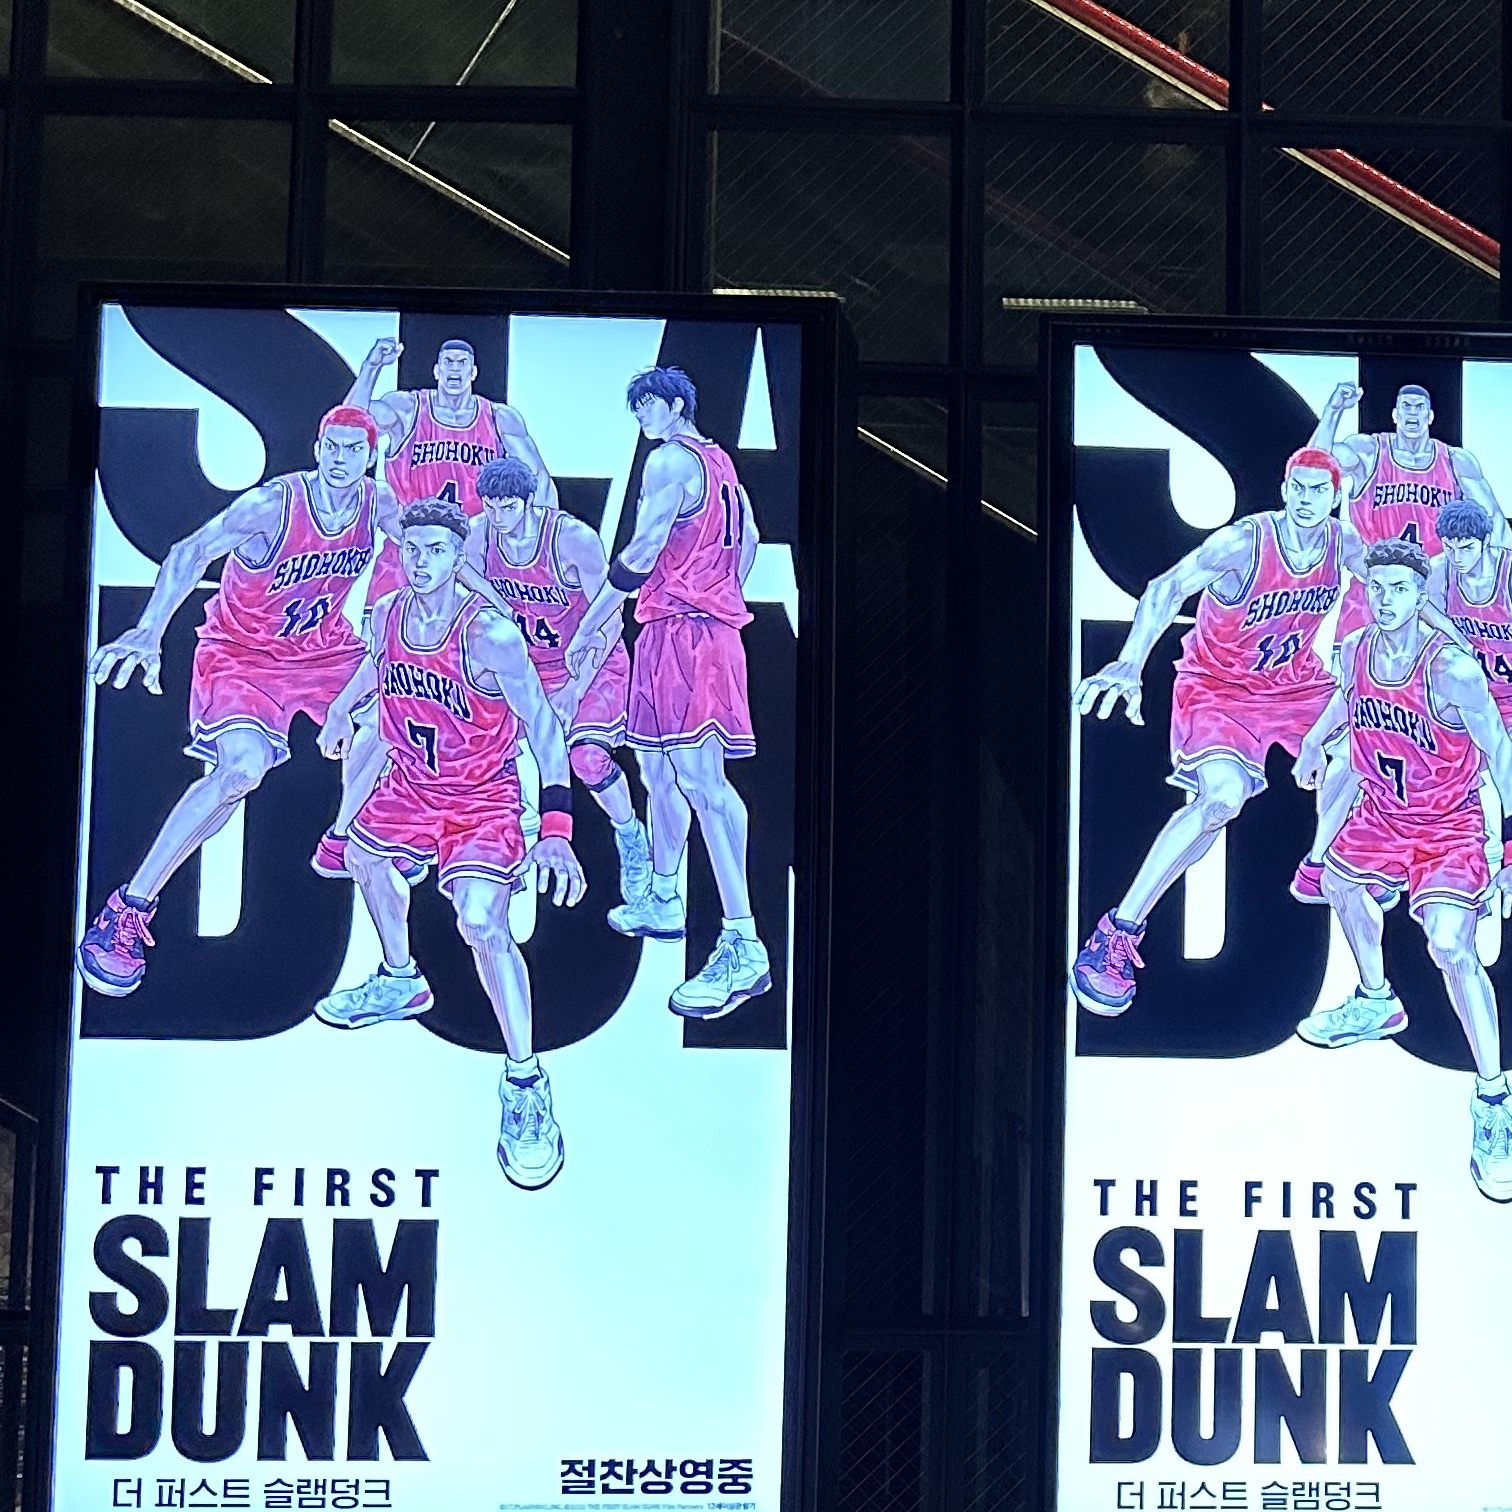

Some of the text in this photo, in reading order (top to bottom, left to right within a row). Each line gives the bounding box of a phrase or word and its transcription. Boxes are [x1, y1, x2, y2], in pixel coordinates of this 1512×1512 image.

[491, 577, 570, 607] HOHOKU
[279, 594, 333, 638] 10
[514, 613, 562, 648] 14
[1252, 631, 1300, 672] 10
[405, 717, 439, 775] 7
[1376, 749, 1408, 807] 7
[95, 1165, 439, 1207] THE FIRST
[1093, 1178, 1417, 1220] THE FIRST
[88, 1214, 439, 1338] SLAM
[1089, 1225, 1418, 1345] SLAM
[85, 1340, 431, 1463] DUNK
[1089, 1347, 1416, 1466] DUNK
[112, 1477, 392, 1509] 더 퍼스트 슬램덩크
[560, 1458, 754, 1495] 절찬상영중
[1117, 1480, 1383, 1511] 더 퍼스트 슬램덩크
